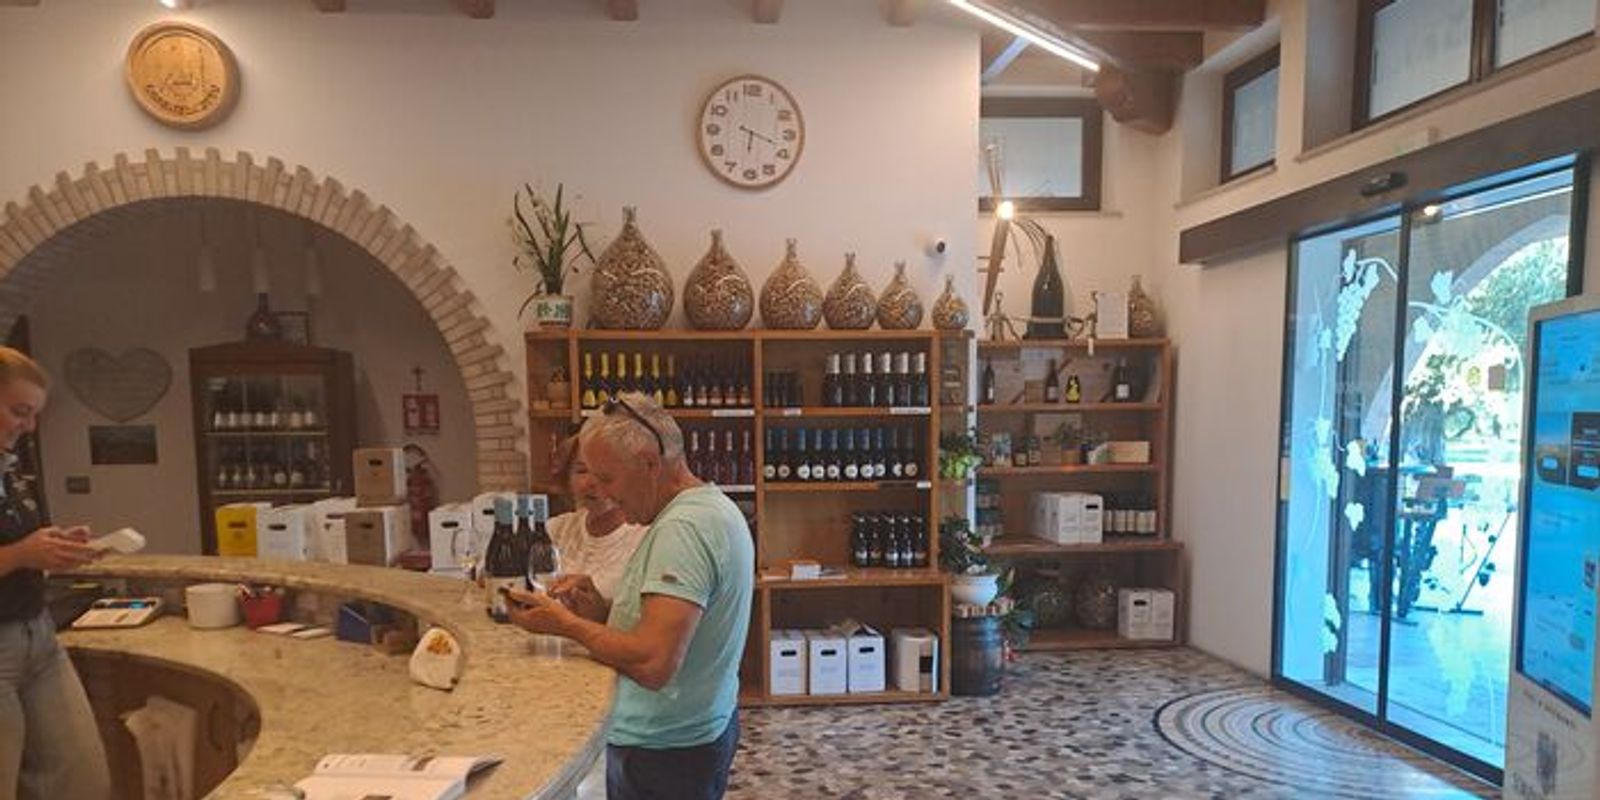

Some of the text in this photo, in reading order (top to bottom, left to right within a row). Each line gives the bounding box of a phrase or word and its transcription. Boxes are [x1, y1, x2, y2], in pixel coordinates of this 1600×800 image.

[725, 89, 738, 102] 11
[743, 84, 762, 97] 12
[711, 104, 728, 116] 10
[783, 129, 796, 141] 3
[724, 161, 737, 173] 7
[762, 164, 776, 176] 5
[743, 169, 756, 180] 6
